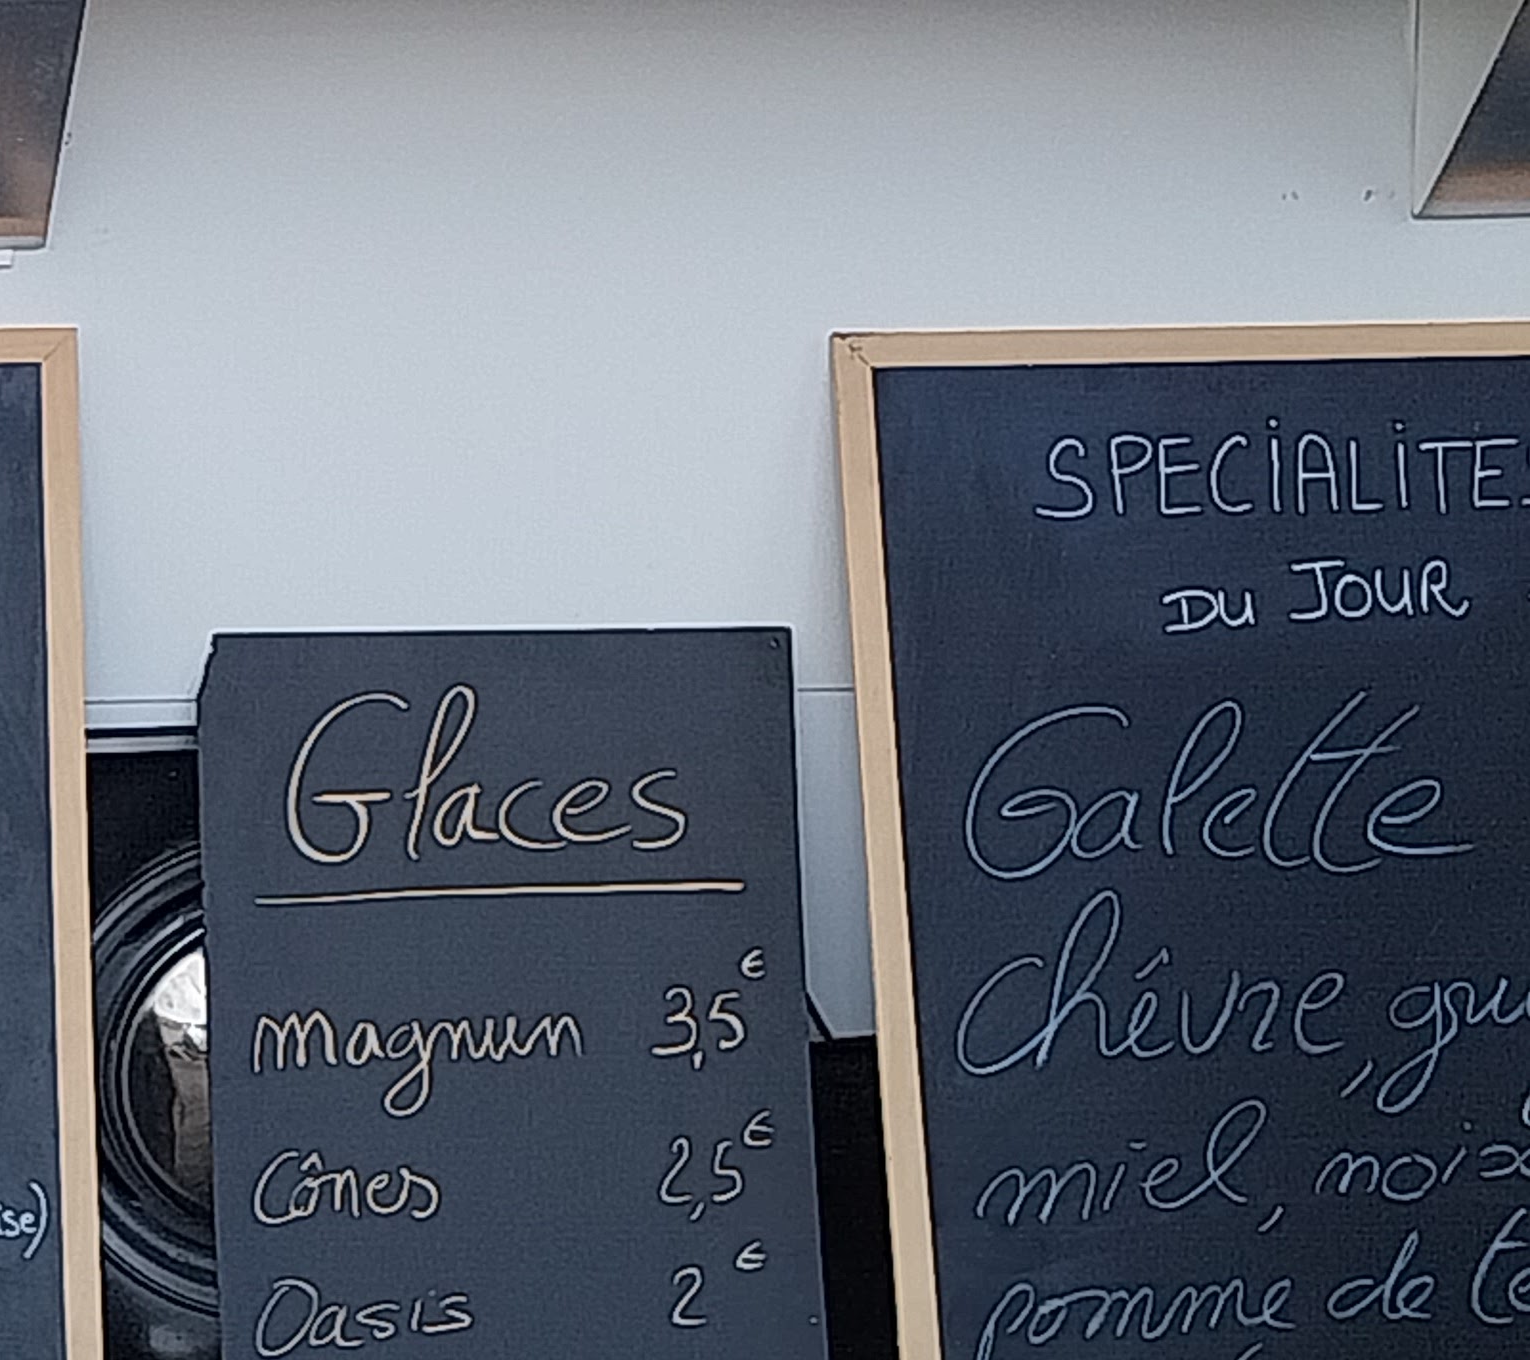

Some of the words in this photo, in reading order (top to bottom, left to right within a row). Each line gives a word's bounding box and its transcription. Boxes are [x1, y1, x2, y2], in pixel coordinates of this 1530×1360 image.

[1034, 418, 1530, 519] SPECIALITE
[1162, 588, 1257, 634] DU
[1289, 559, 1470, 621] JOUR
[285, 684, 688, 864] Glaces
[965, 690, 1475, 881] Galette
[252, 1150, 441, 1226] Cônes
[253, 1277, 475, 1359] Oasis
[1325, 1229, 1437, 1322] de
